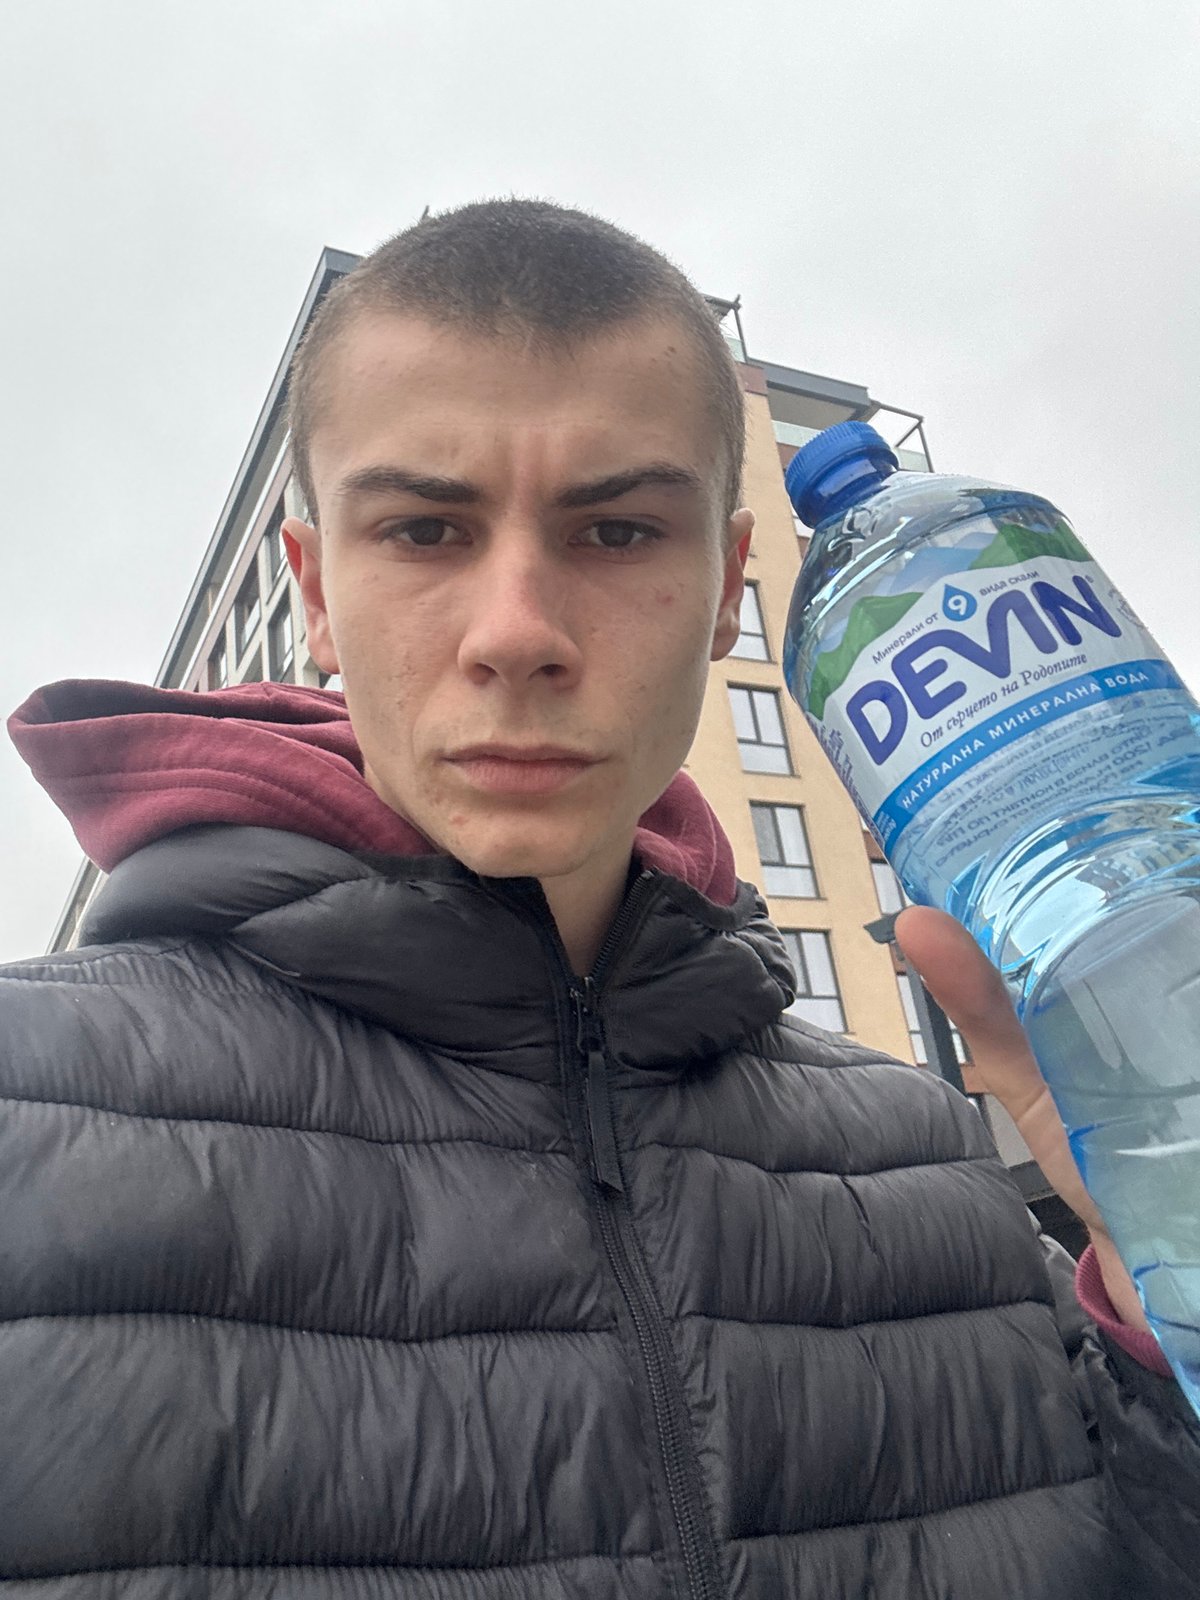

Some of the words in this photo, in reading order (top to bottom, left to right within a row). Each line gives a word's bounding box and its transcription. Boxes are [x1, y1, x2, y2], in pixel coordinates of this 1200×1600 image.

[845, 575, 1122, 767] DEVIN
[872, 620, 925, 665] Минерали
[925, 611, 940, 624] от
[947, 594, 966, 616] 9
[979, 580, 1008, 598] вида
[1008, 570, 1041, 586] скали
[901, 738, 986, 810] НАТУРАЛНА
[988, 684, 1103, 740] МИНЕРАЛНА
[1104, 670, 1150, 691] ВОДА
[920, 727, 944, 748] От
[946, 692, 999, 731] сърцето
[1001, 681, 1020, 698] на
[1019, 651, 1088, 687] Родопите
